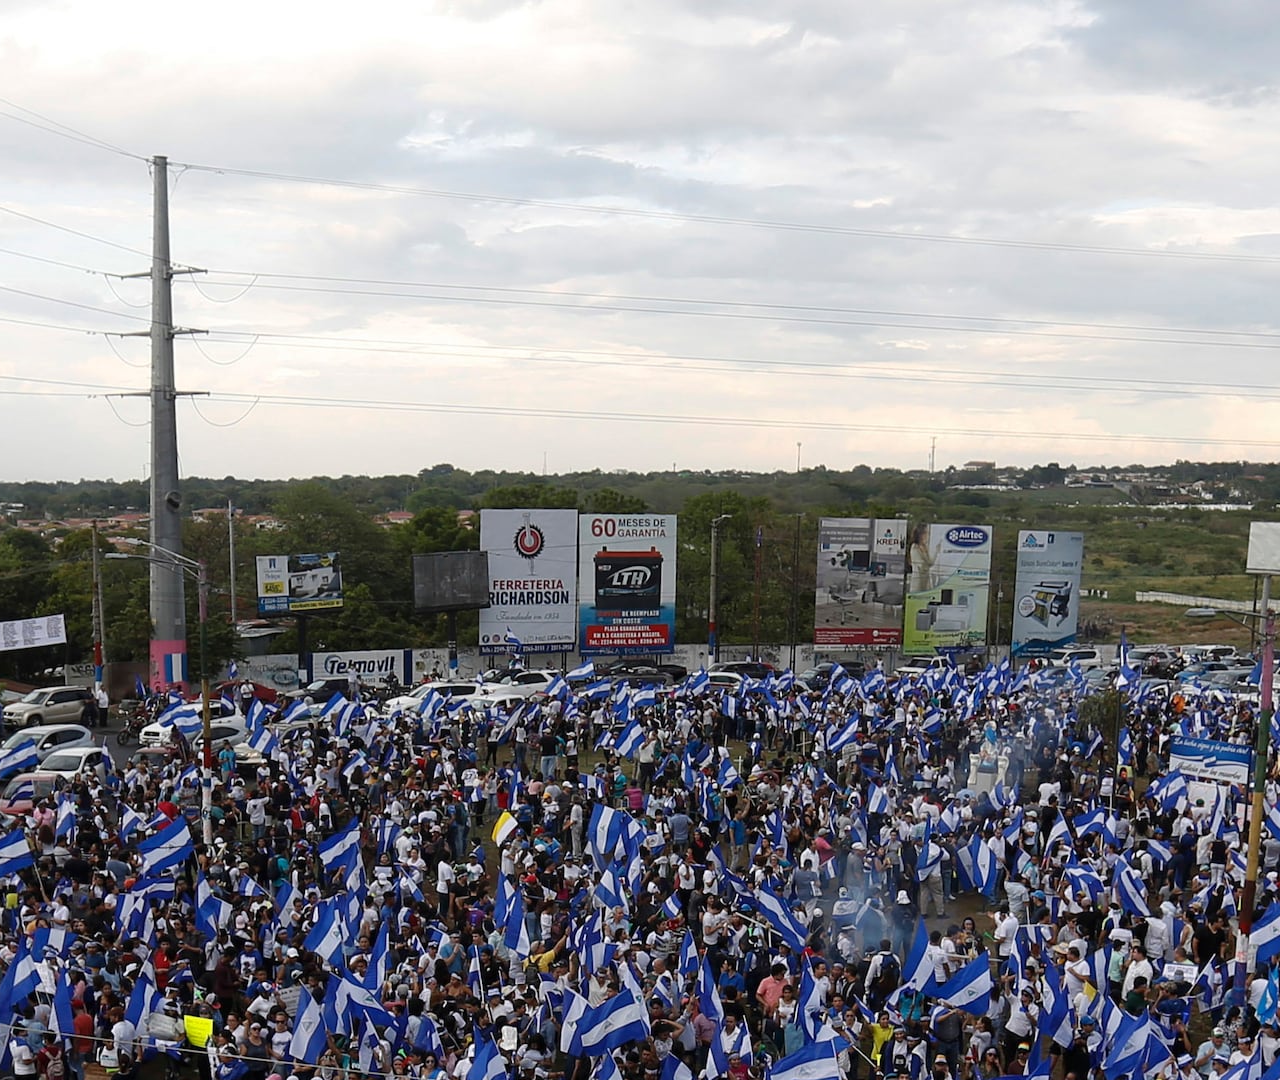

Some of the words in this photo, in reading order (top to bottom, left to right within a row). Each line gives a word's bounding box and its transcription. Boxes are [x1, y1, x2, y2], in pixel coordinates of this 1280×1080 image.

[591, 518, 616, 537] 60
[618, 518, 651, 527] MESES
[653, 518, 666, 527] DE
[617, 527, 666, 537] GARANTÍA
[959, 530, 984, 539] Airtec
[493, 579, 564, 590] FERRETERIA
[611, 571, 644, 586] LTH
[489, 591, 569, 606] RICHARDSON
